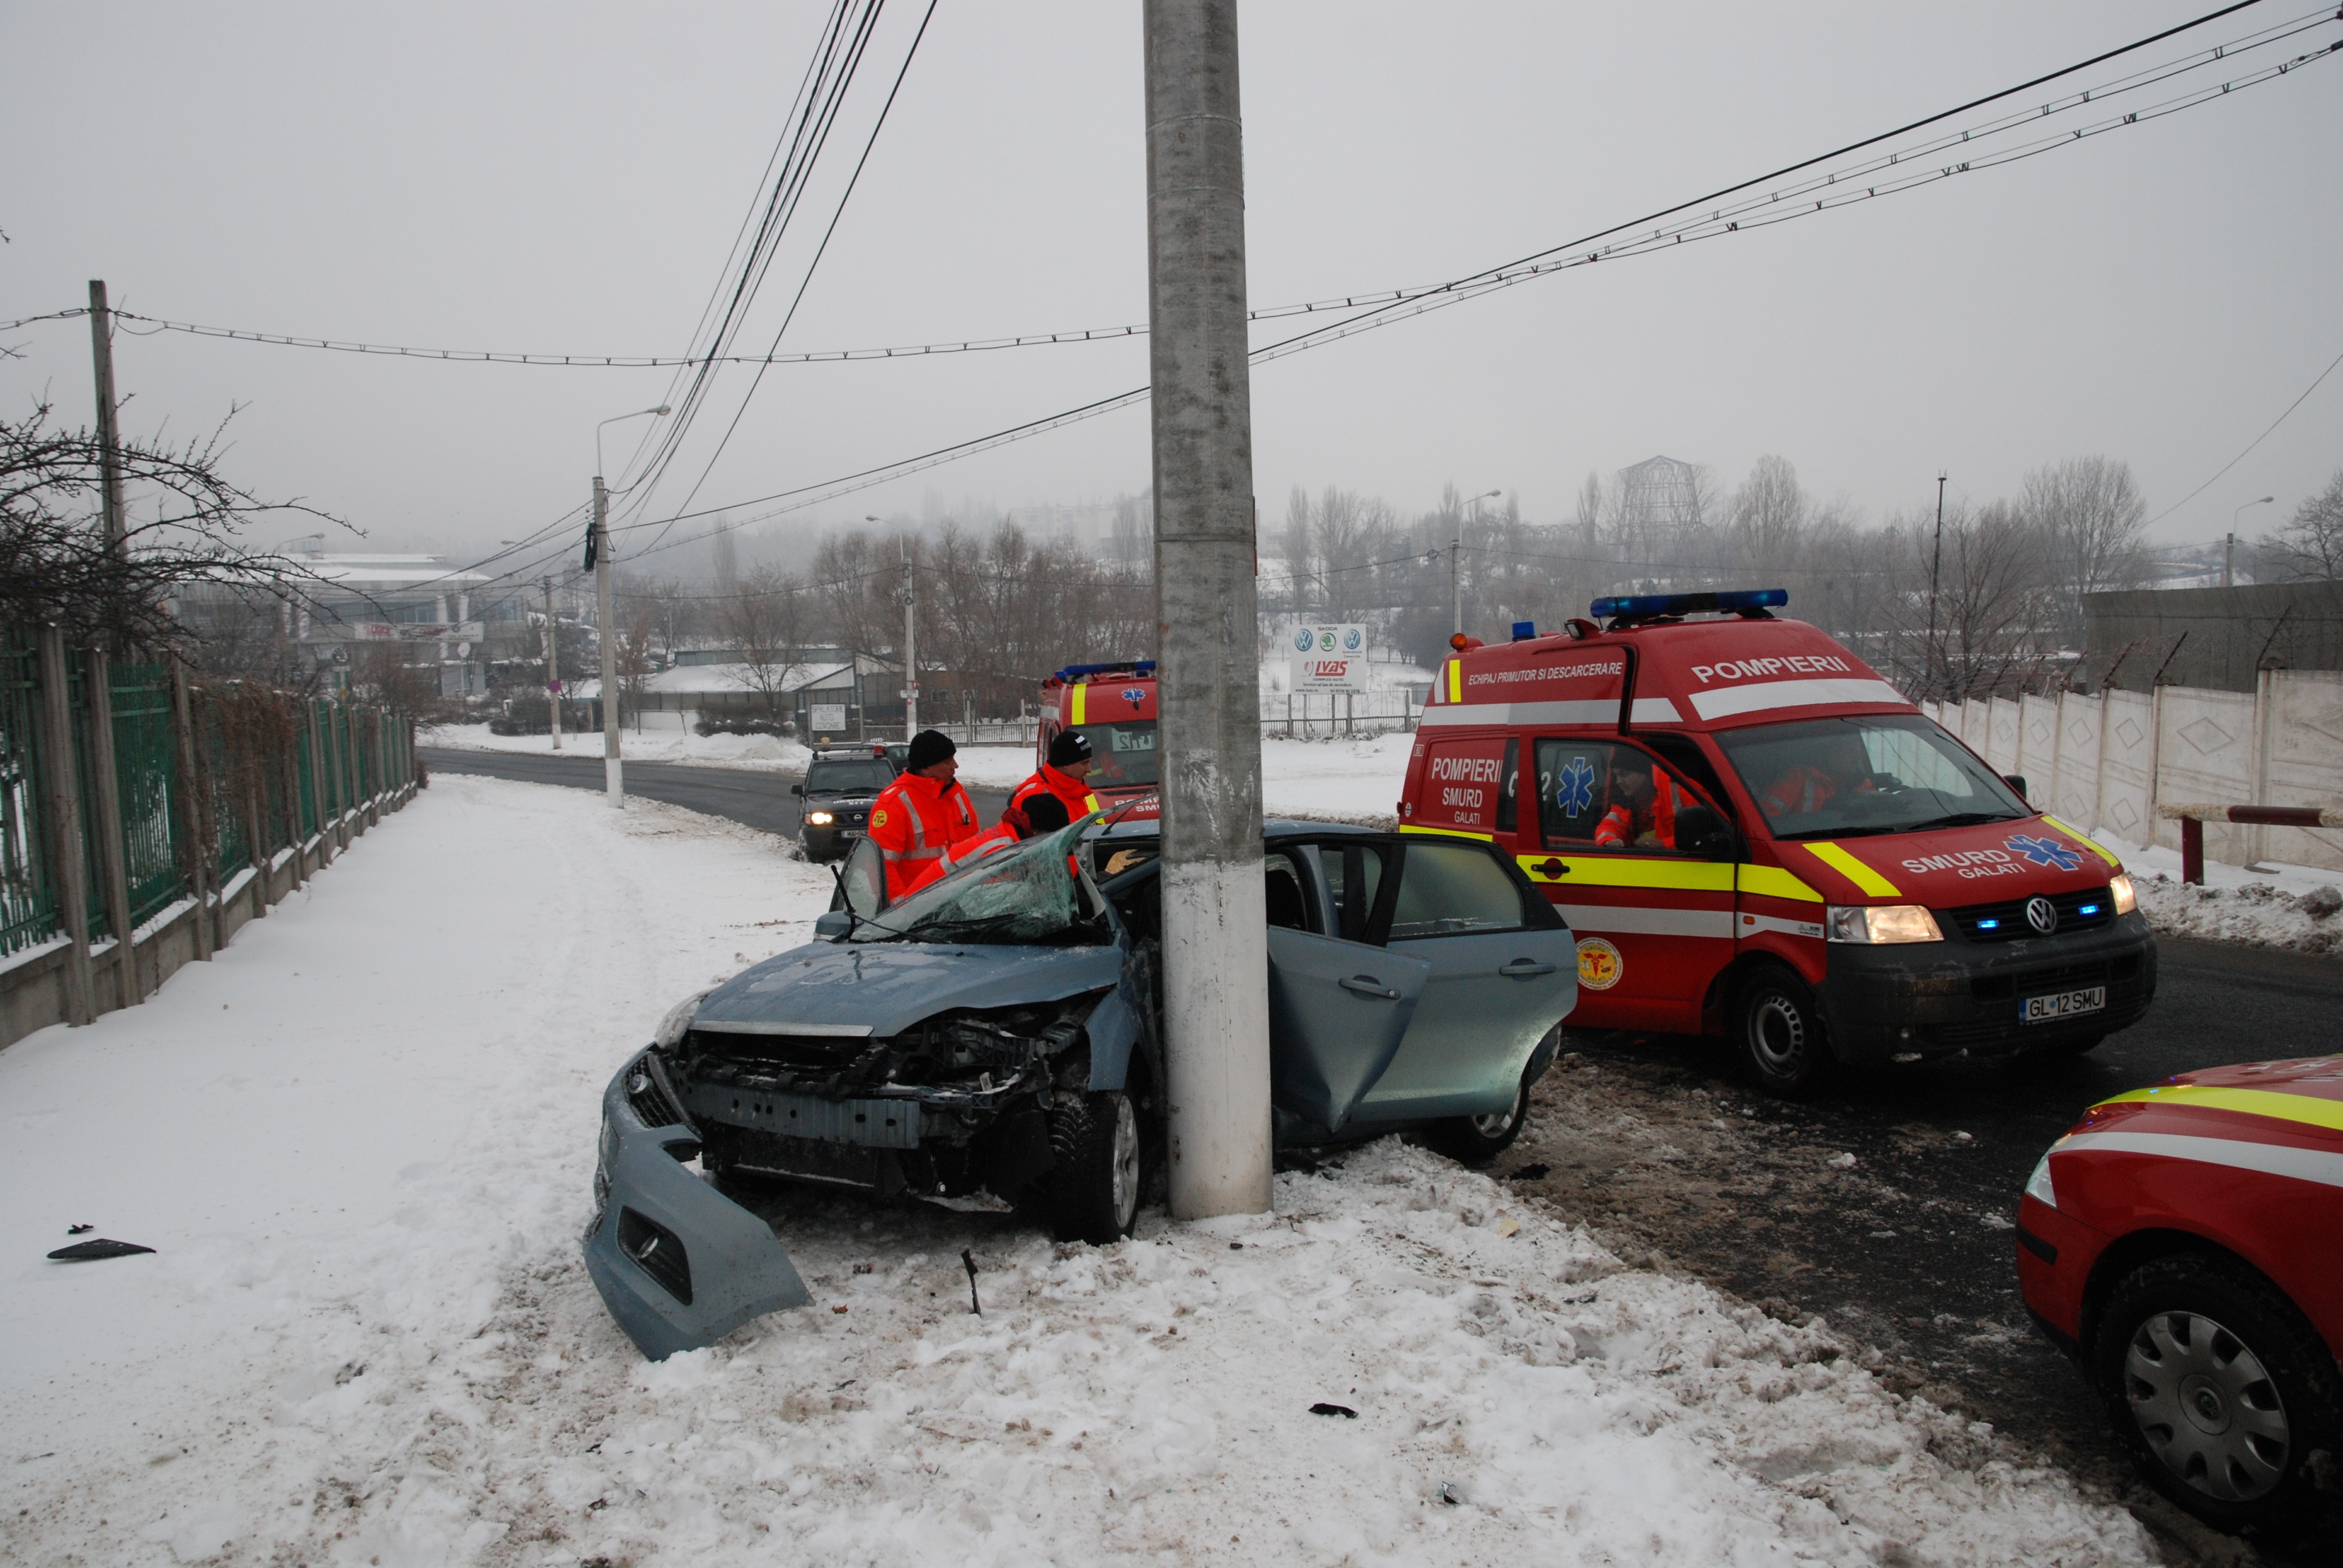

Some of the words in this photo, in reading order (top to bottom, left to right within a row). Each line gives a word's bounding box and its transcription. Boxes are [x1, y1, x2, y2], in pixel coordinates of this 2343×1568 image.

[1469, 674, 1496, 685] ECHIPAJ
[1538, 668, 1546, 680] SI
[1547, 662, 1623, 679] DESCARCERARE
[1691, 656, 1852, 683] POMPIERII
[1432, 757, 1504, 783] POMPIERII
[1442, 787, 1483, 808] SMURD
[1455, 811, 1480, 825] GALATI
[1901, 849, 2011, 874] SMURD
[1958, 862, 2027, 880] GALATI
[2030, 998, 2050, 1017] GL
[2056, 995, 2069, 1014] 12
[2073, 988, 2102, 1010] SMU
